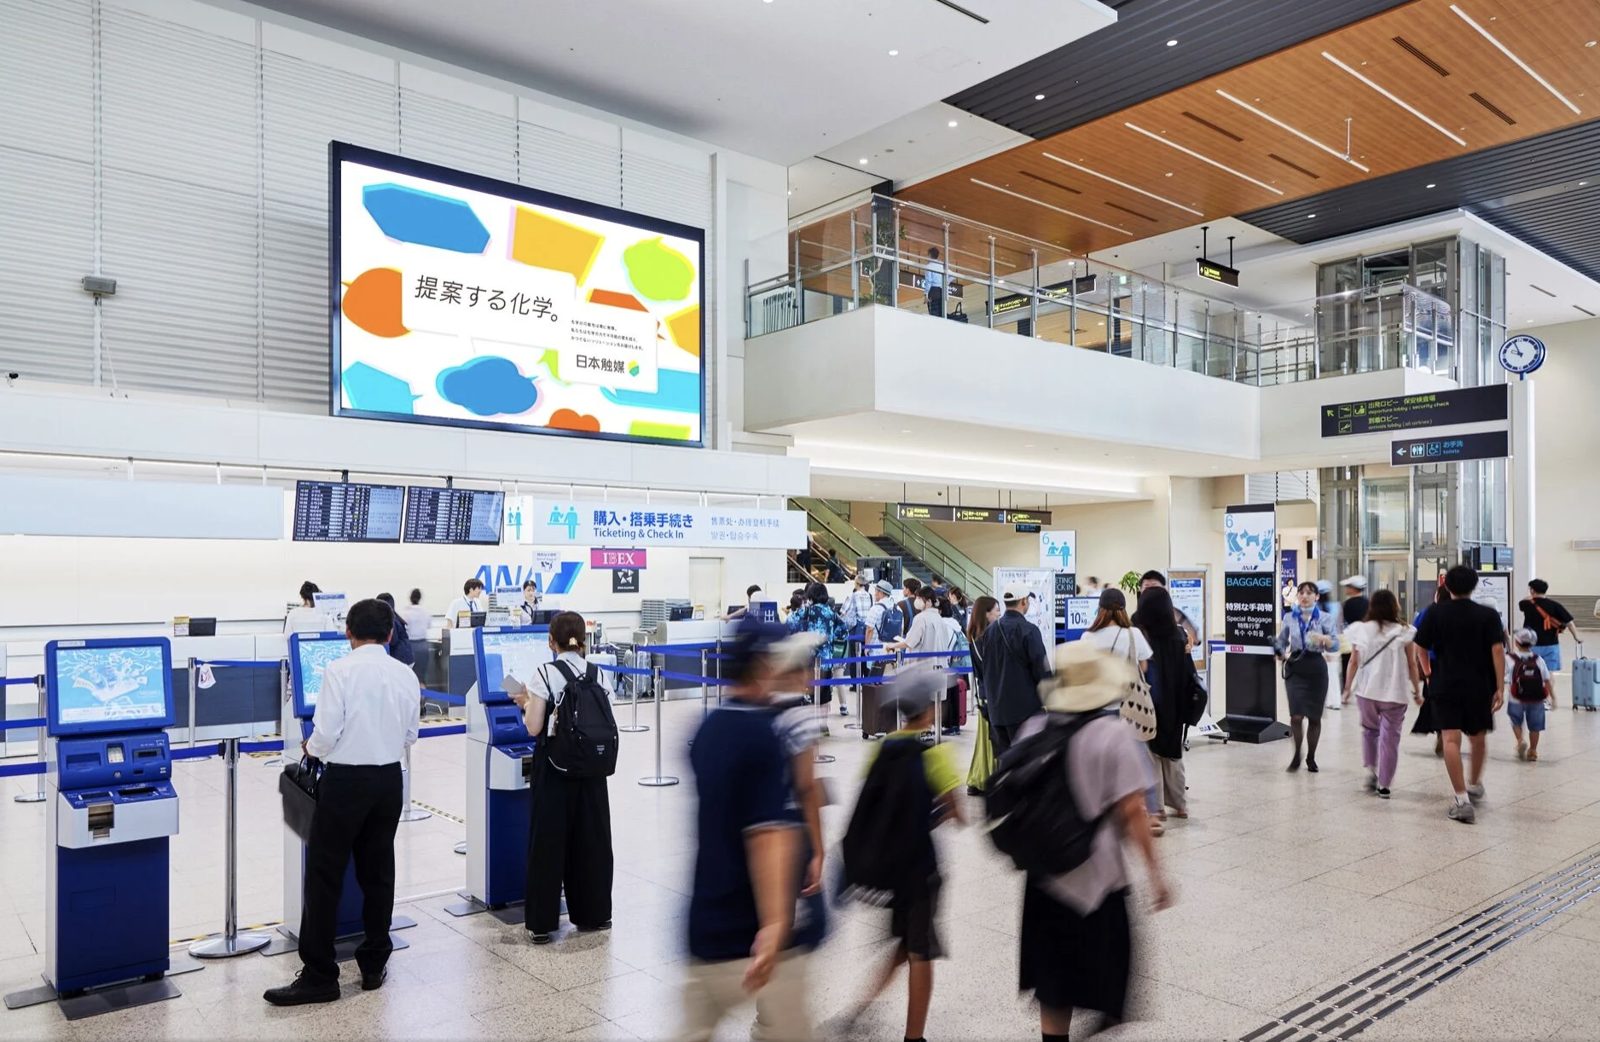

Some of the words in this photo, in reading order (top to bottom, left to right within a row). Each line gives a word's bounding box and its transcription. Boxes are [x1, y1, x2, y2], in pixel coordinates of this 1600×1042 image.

[414, 274, 558, 322] 提案する化学。
[576, 354, 625, 373] 日本触媒
[593, 510, 694, 528] 購入・搭乗手続き
[1225, 514, 1234, 528] 6
[593, 527, 637, 540] Ticketing
[638, 528, 645, 539] &
[646, 528, 674, 540] Check
[675, 529, 684, 539] In
[1042, 533, 1050, 545] 6
[602, 552, 635, 565] IBEX
[1226, 577, 1272, 588] BAGGAGE
[1226, 602, 1273, 612] 特別な手荷物
[1226, 615, 1246, 623] Special
[1247, 616, 1273, 624] Baggage
